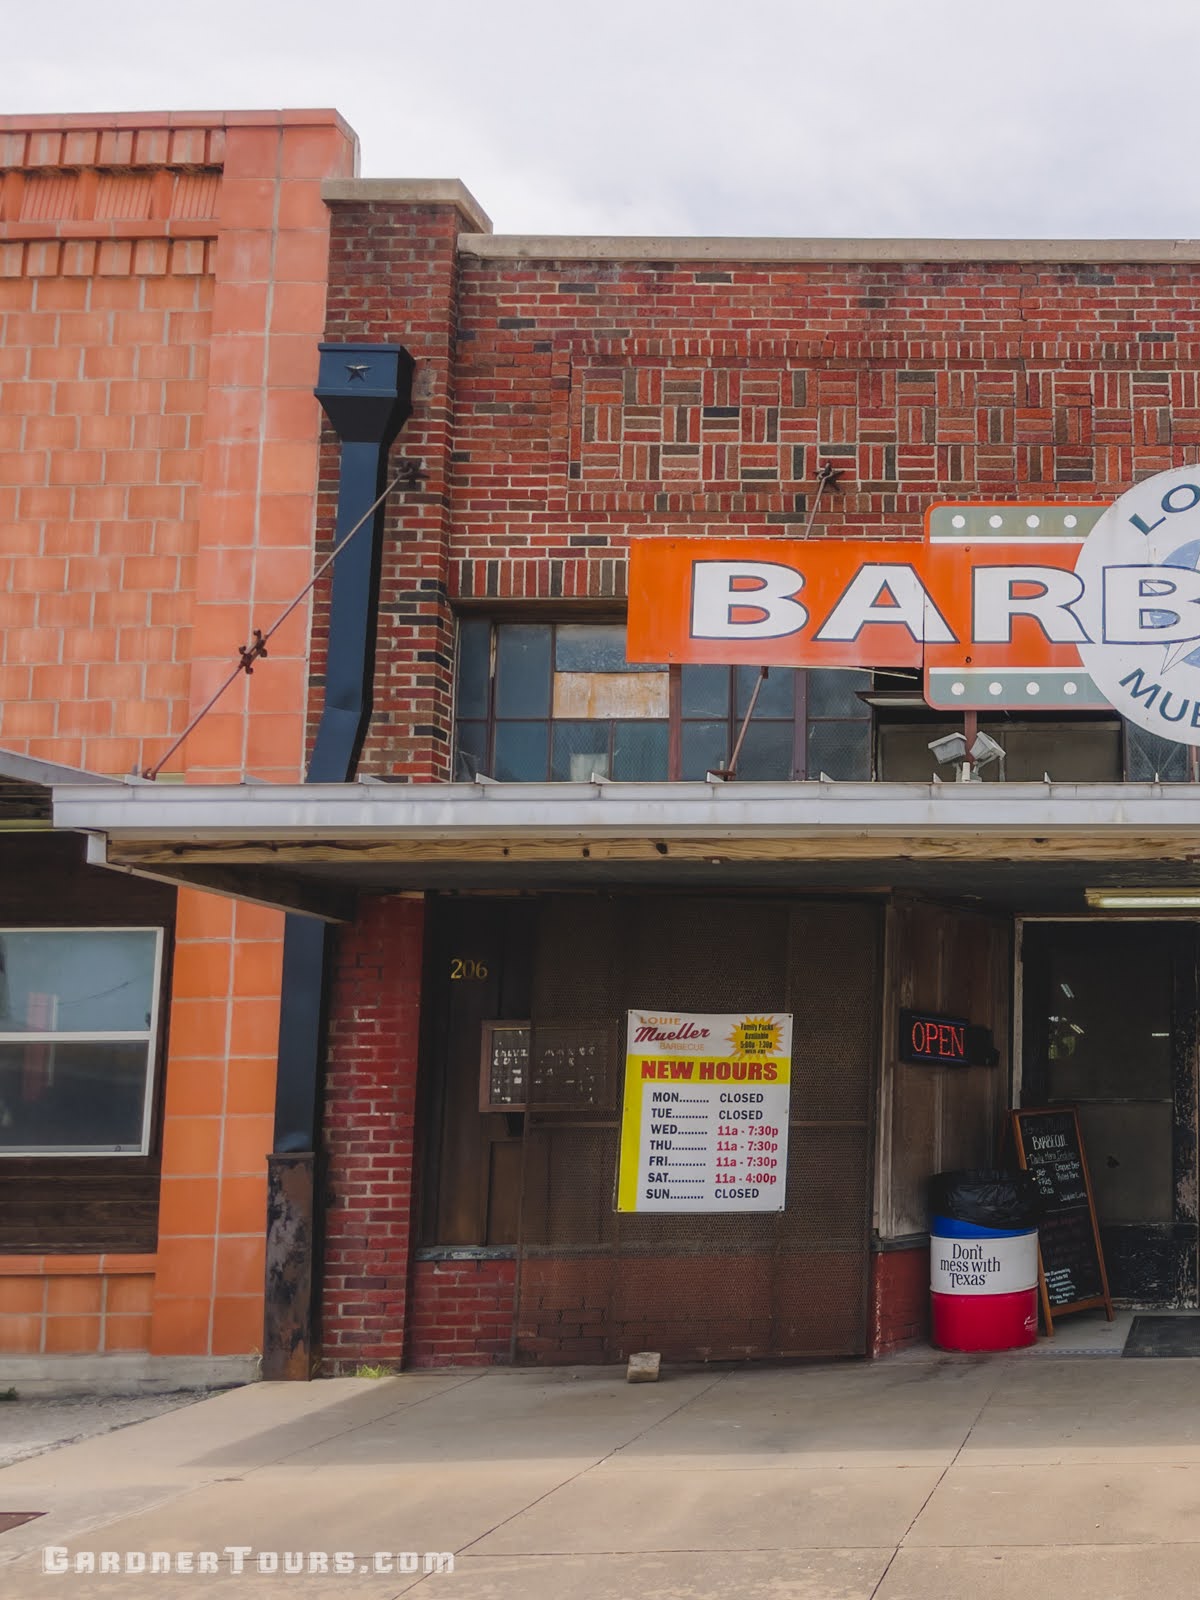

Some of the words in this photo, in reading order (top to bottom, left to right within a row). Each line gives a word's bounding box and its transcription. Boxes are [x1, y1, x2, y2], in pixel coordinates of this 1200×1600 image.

[450, 959, 488, 980] 206
[640, 1016, 682, 1025] LOUIE
[634, 1022, 710, 1043] Mueller
[911, 1021, 965, 1057] OPEN
[641, 1060, 694, 1080] NEW
[700, 1061, 778, 1081] HOURS
[719, 1093, 764, 1103] CLOSED
[718, 1110, 763, 1120] CLOSED
[717, 1125, 738, 1136] 11a
[748, 1125, 779, 1138] 7:30p
[716, 1141, 738, 1151] 11a
[747, 1141, 778, 1153] 7:30p
[716, 1156, 737, 1167] 11a
[746, 1156, 778, 1168] 7:30p
[715, 1173, 736, 1184] 11a
[745, 1173, 777, 1185] 4:00p
[714, 1188, 760, 1199] CLOSED
[952, 1243, 984, 1260] Don't
[940, 1258, 969, 1273] mess
[971, 1257, 1001, 1273] with
[949, 1272, 986, 1288] Texas
